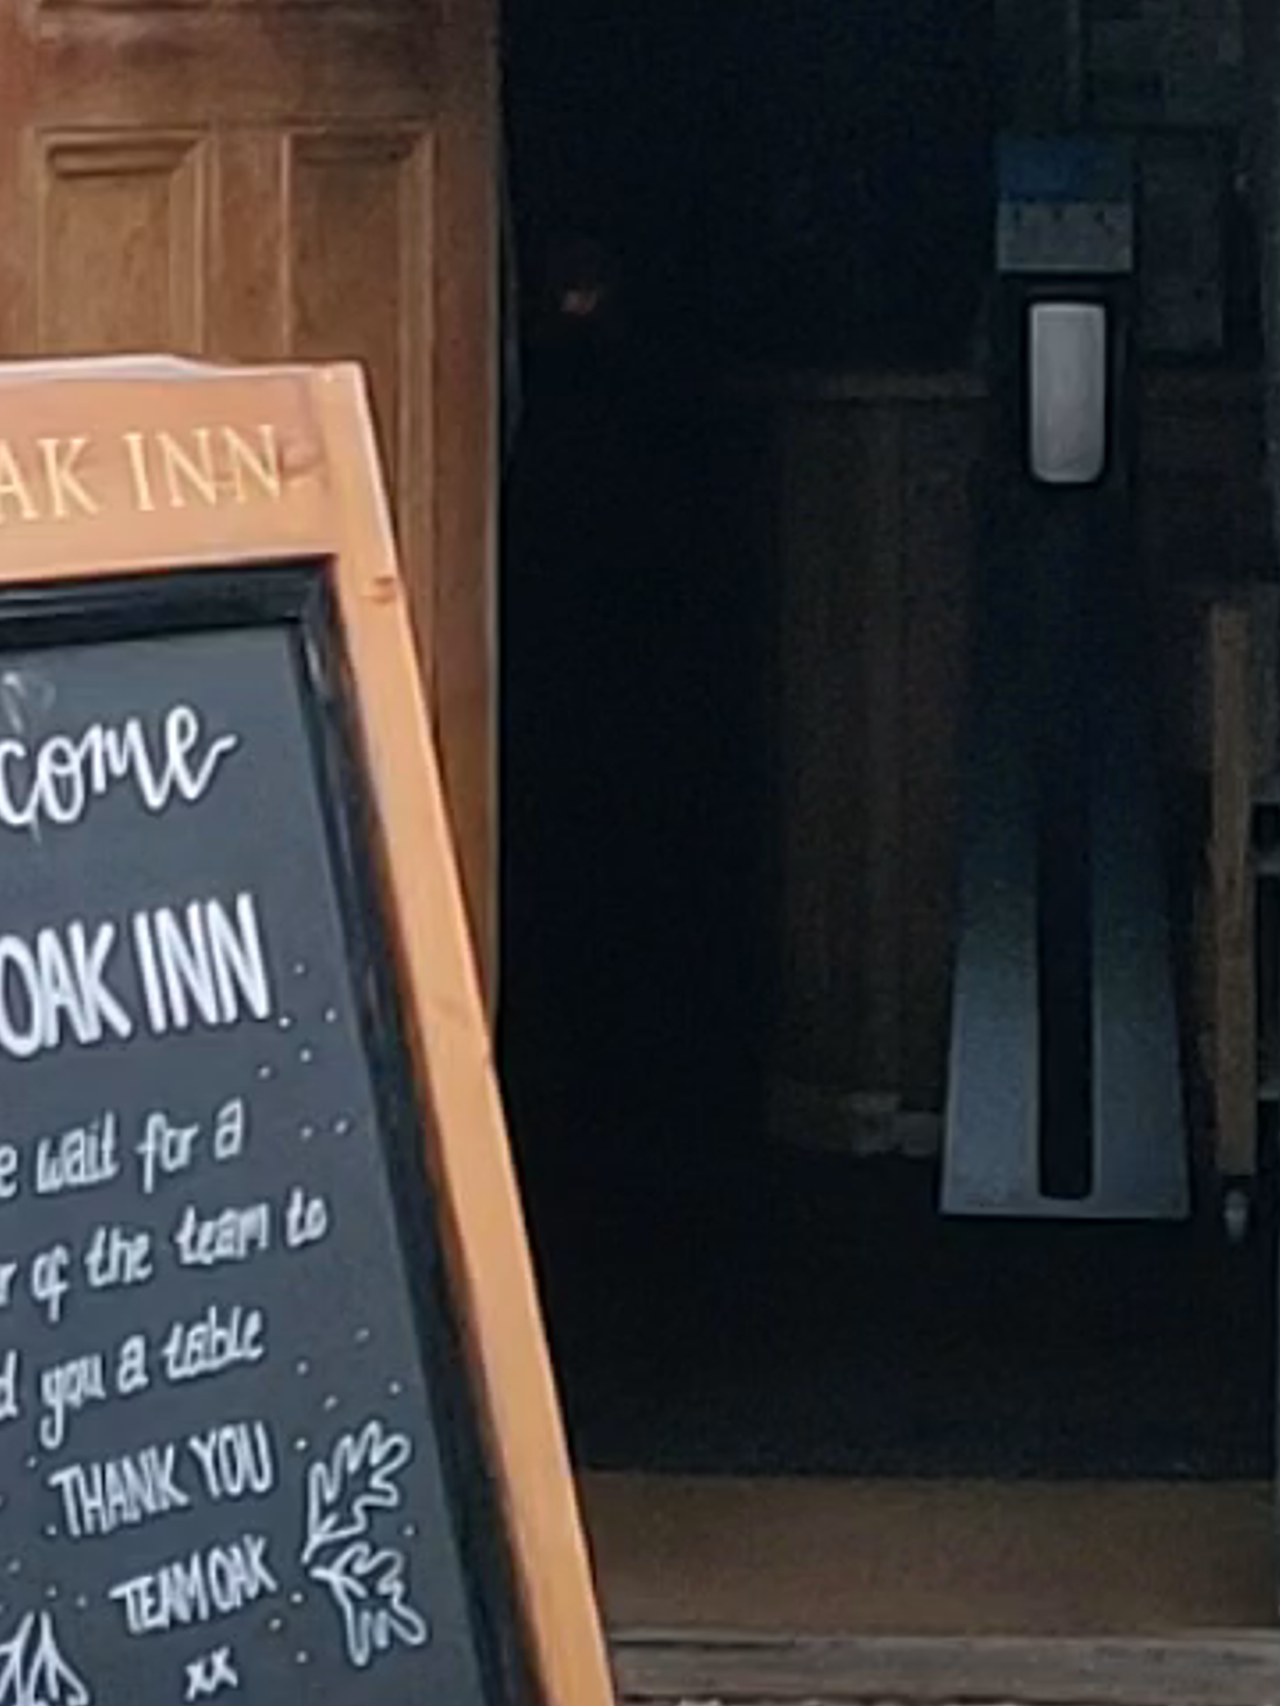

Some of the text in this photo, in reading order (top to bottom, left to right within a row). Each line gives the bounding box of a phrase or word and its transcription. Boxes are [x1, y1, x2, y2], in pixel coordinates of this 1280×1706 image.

[124, 424, 282, 512] INN
[132, 893, 270, 1033] INN
[36, 1111, 118, 1193] wait
[136, 1112, 199, 1192] for
[214, 1097, 244, 1159] a
[31, 1245, 68, 1322] of
[84, 1227, 153, 1286] the
[173, 1200, 269, 1265] team
[286, 1189, 327, 1246] to
[40, 1357, 106, 1449] you
[117, 1335, 148, 1389] a
[162, 1306, 265, 1381] table
[49, 1421, 274, 1538] THANK YOU
[109, 1533, 277, 1635] TEAM OAK
